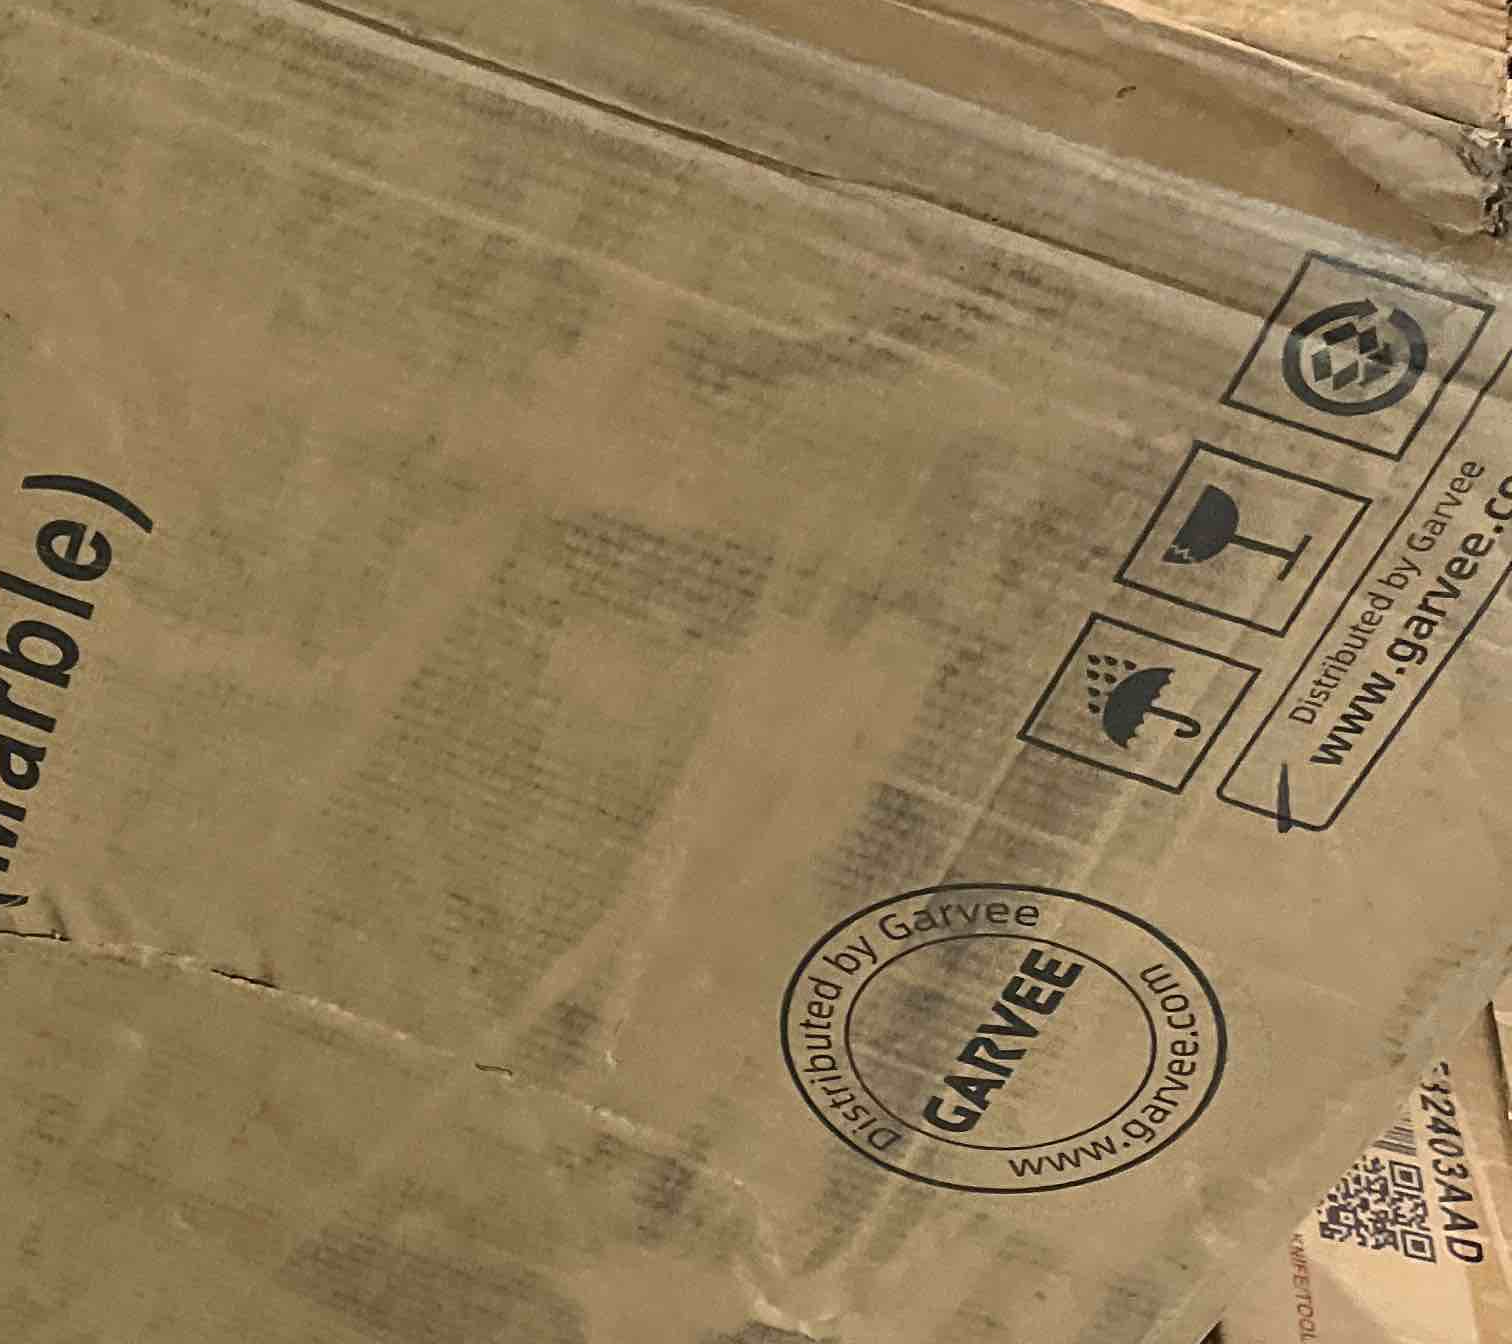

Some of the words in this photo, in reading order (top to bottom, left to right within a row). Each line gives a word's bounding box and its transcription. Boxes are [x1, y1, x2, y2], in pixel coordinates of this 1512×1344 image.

[1288, 590, 1394, 726] Distributed
[1377, 556, 1423, 591] by
[1406, 459, 1485, 553] Garvee
[822, 934, 879, 976] by
[878, 900, 1041, 942] Garvee
[799, 975, 903, 1152] Distributed
[921, 948, 1085, 1133] GARVEE
[1008, 963, 1199, 1179] www.garvee.com
